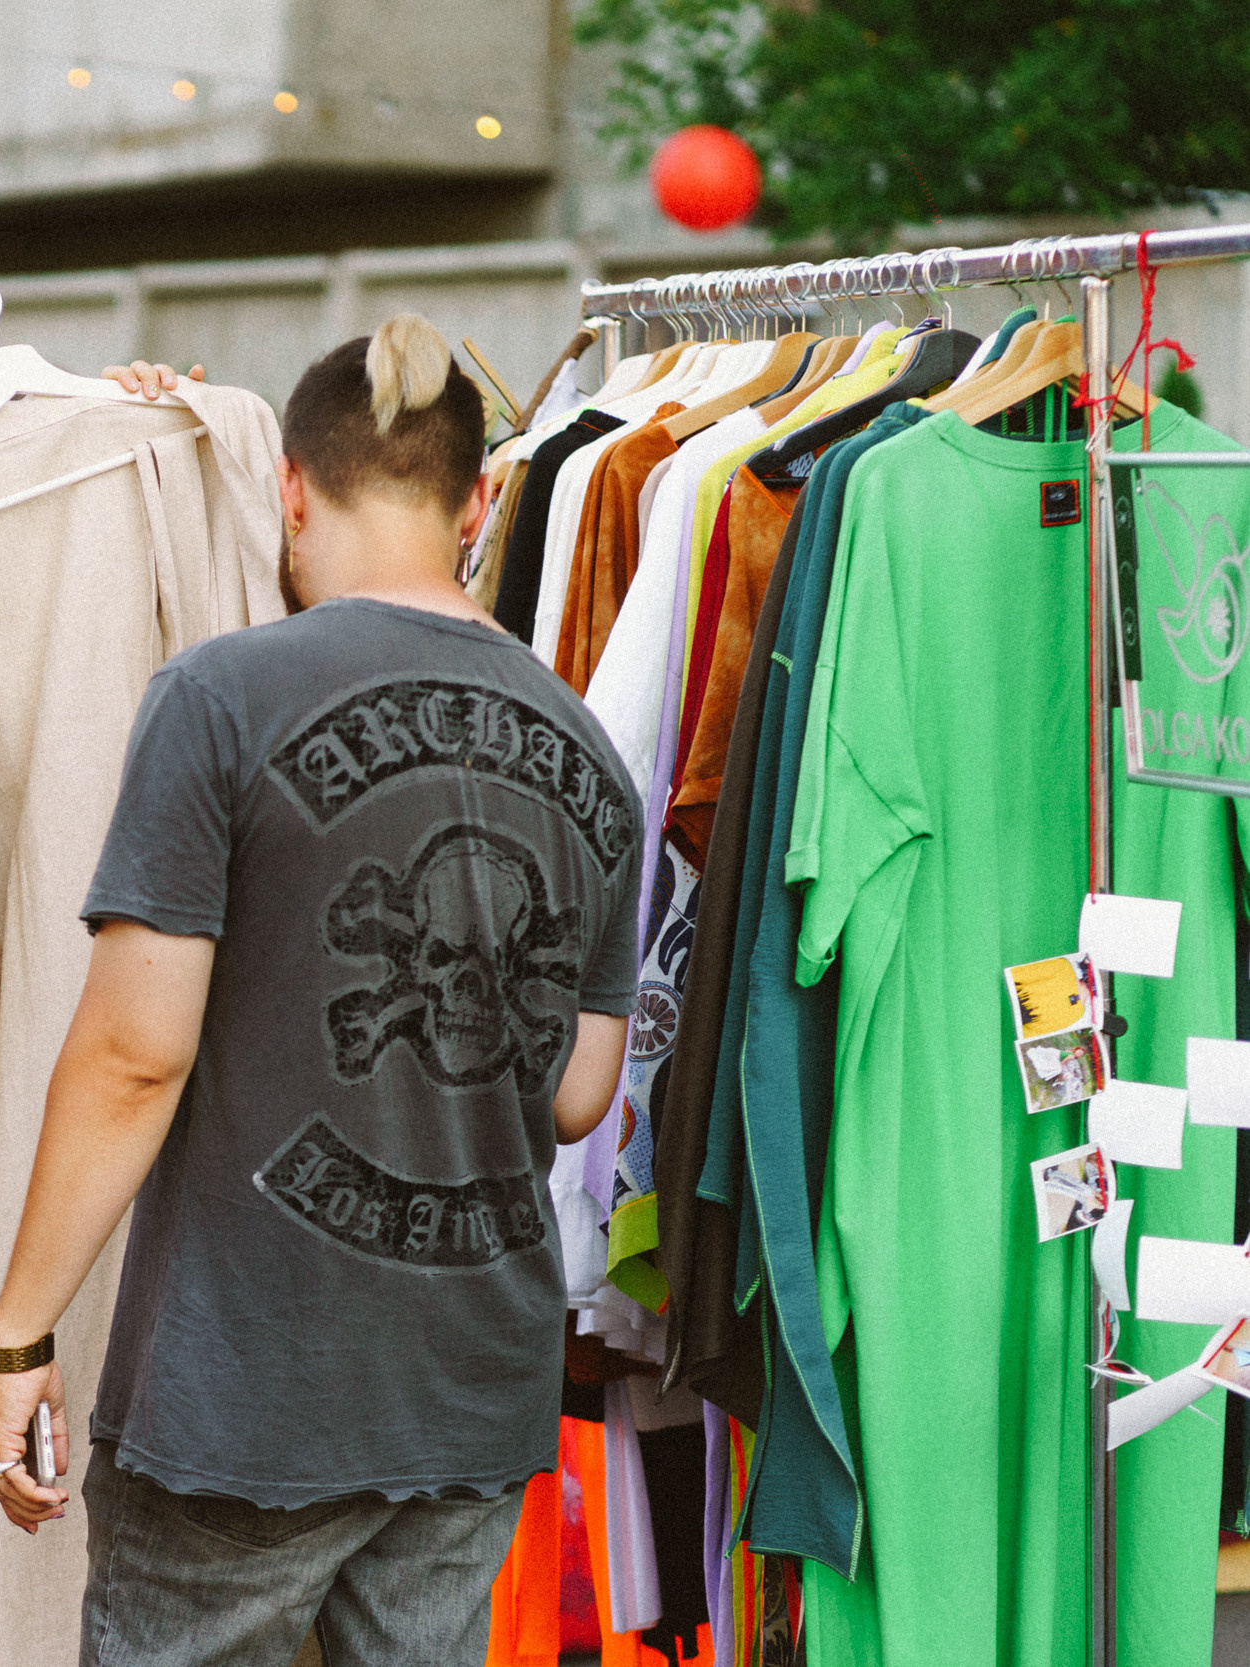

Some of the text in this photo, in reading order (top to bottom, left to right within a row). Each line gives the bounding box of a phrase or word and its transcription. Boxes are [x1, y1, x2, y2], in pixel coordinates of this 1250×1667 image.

[1213, 714, 1250, 764] KO
[272, 1141, 537, 1260] Los Ange
